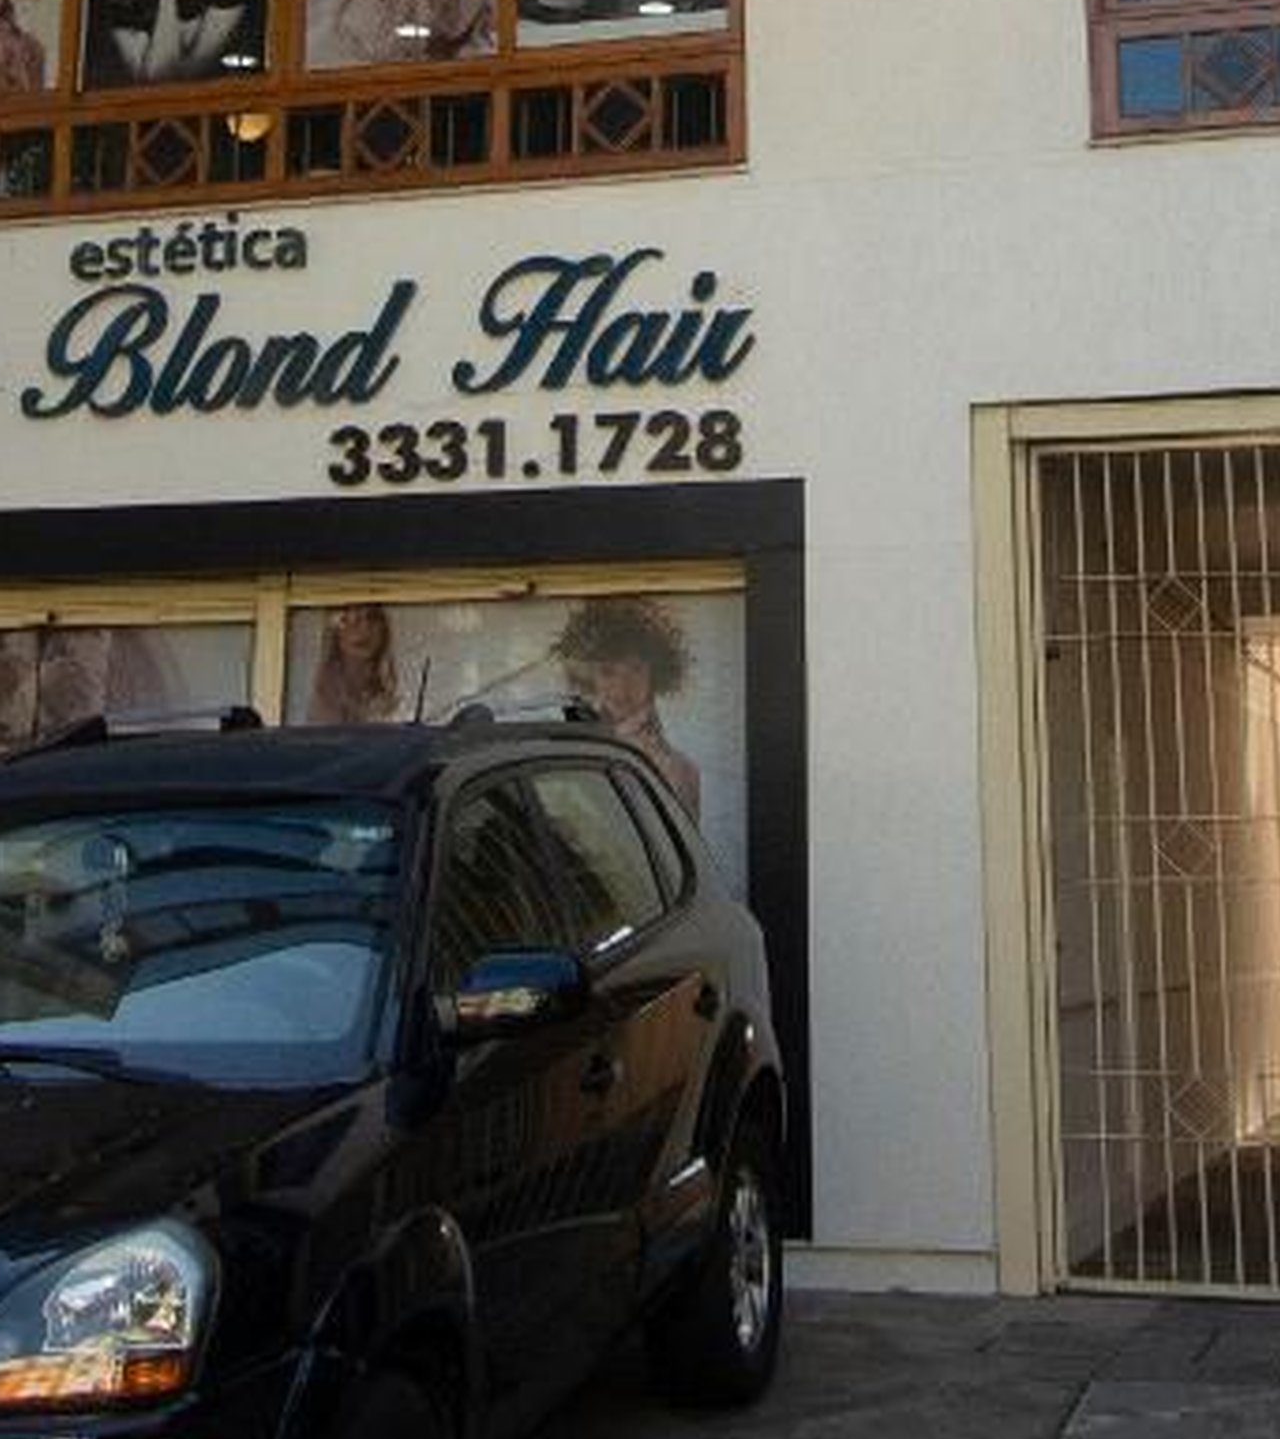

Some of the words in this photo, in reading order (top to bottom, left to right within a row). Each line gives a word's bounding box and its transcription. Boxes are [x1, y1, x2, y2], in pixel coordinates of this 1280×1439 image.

[70, 212, 308, 280] estética
[21, 280, 418, 419] Blond
[452, 248, 756, 394] Hair
[328, 410, 743, 486] 3331.1728
